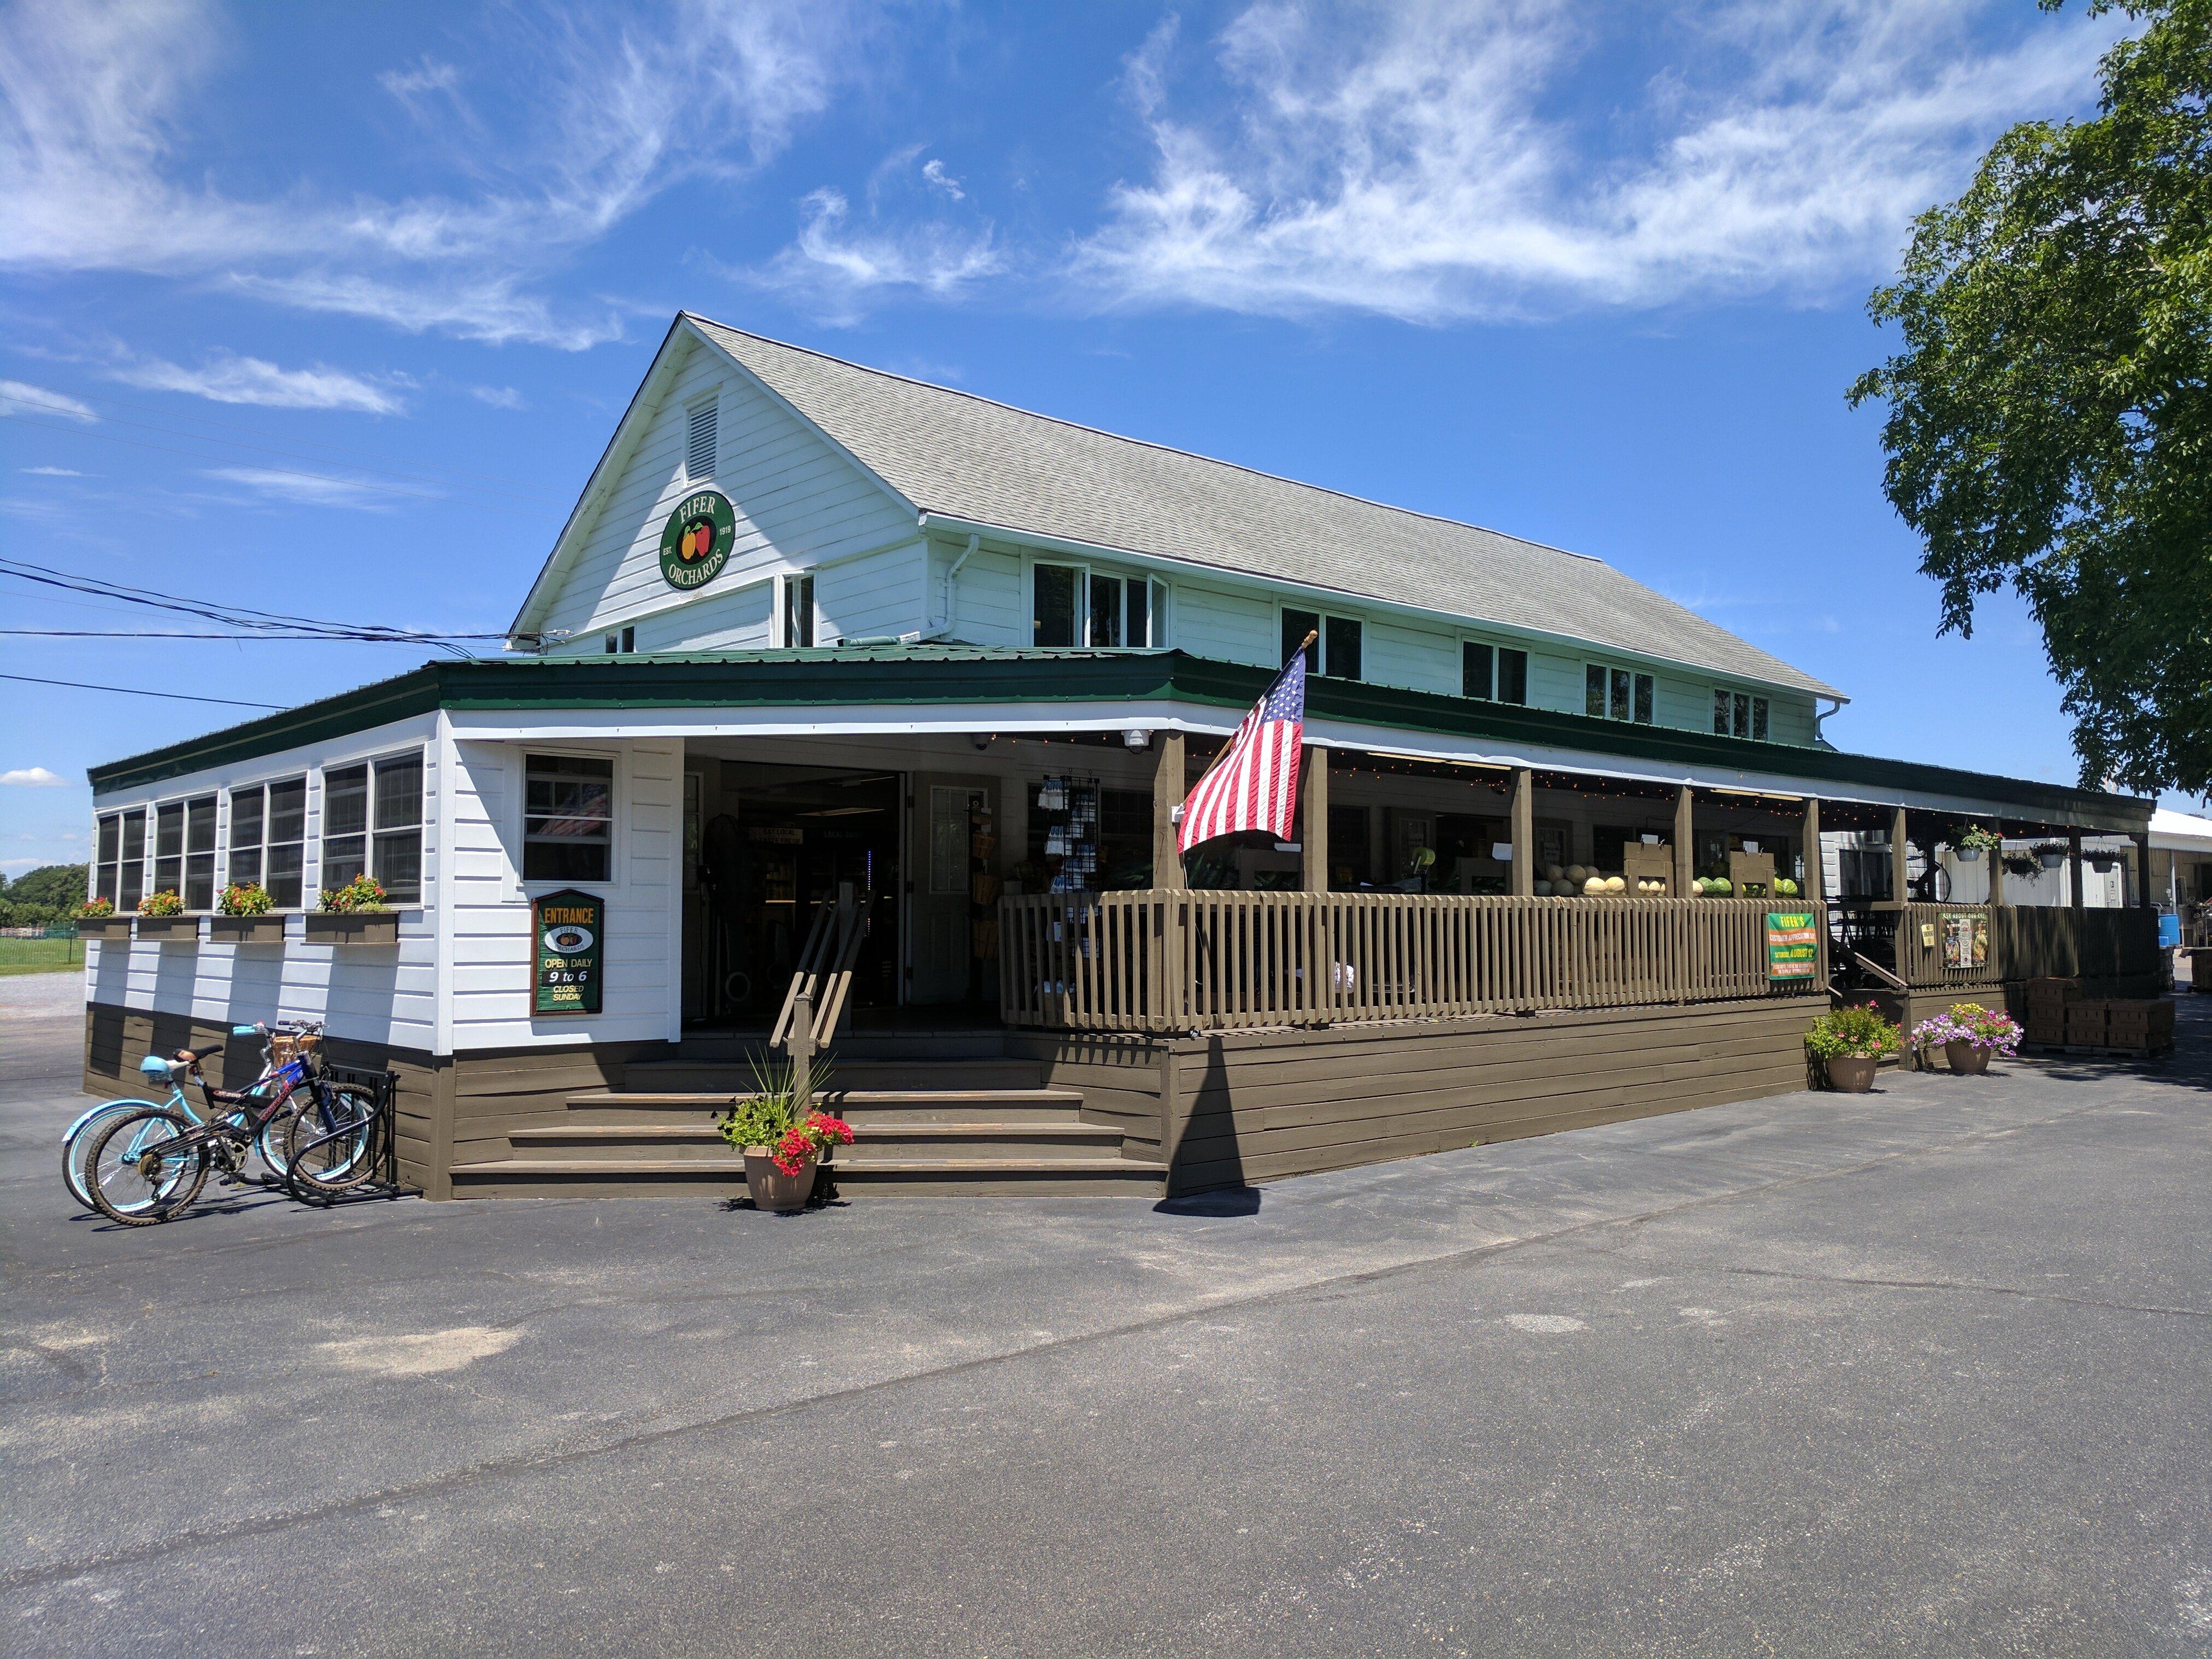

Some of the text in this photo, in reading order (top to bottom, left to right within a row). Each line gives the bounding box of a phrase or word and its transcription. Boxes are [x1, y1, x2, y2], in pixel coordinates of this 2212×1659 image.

[679, 496, 715, 524] FIFER
[719, 525, 731, 536] 1919
[663, 546, 672, 556] EST.
[668, 549, 723, 585] ORCHARDS
[544, 907, 593, 924] ENTRANCE
[1780, 916, 1804, 927] FIFER'S
[1790, 948, 1808, 958] AUGUST
[545, 958, 592, 968] OPEN DAILY
[549, 970, 587, 983] 9 to 6
[553, 985, 584, 993] CLOSED
[552, 993, 583, 1001] SUNDAY
[260, 1079, 297, 1121] MONGOOSE
